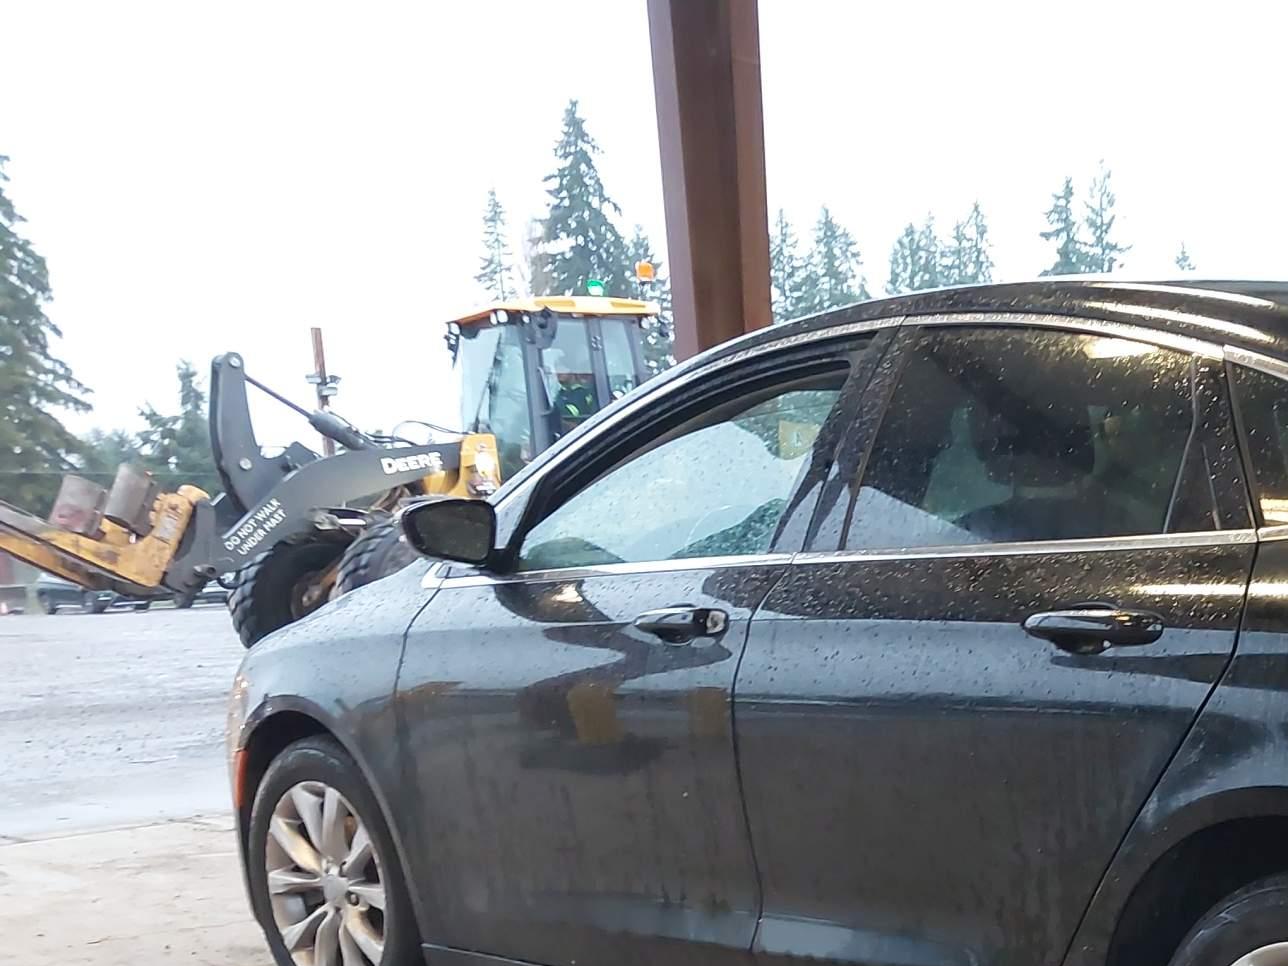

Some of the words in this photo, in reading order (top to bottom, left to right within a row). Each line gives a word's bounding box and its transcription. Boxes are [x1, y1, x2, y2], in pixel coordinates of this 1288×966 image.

[380, 452, 443, 475] DEERE
[223, 535, 241, 551] DO
[236, 518, 258, 539] NOT
[254, 498, 281, 522] WALK
[236, 528, 268, 555] UNDER
[262, 508, 287, 532] MAST
